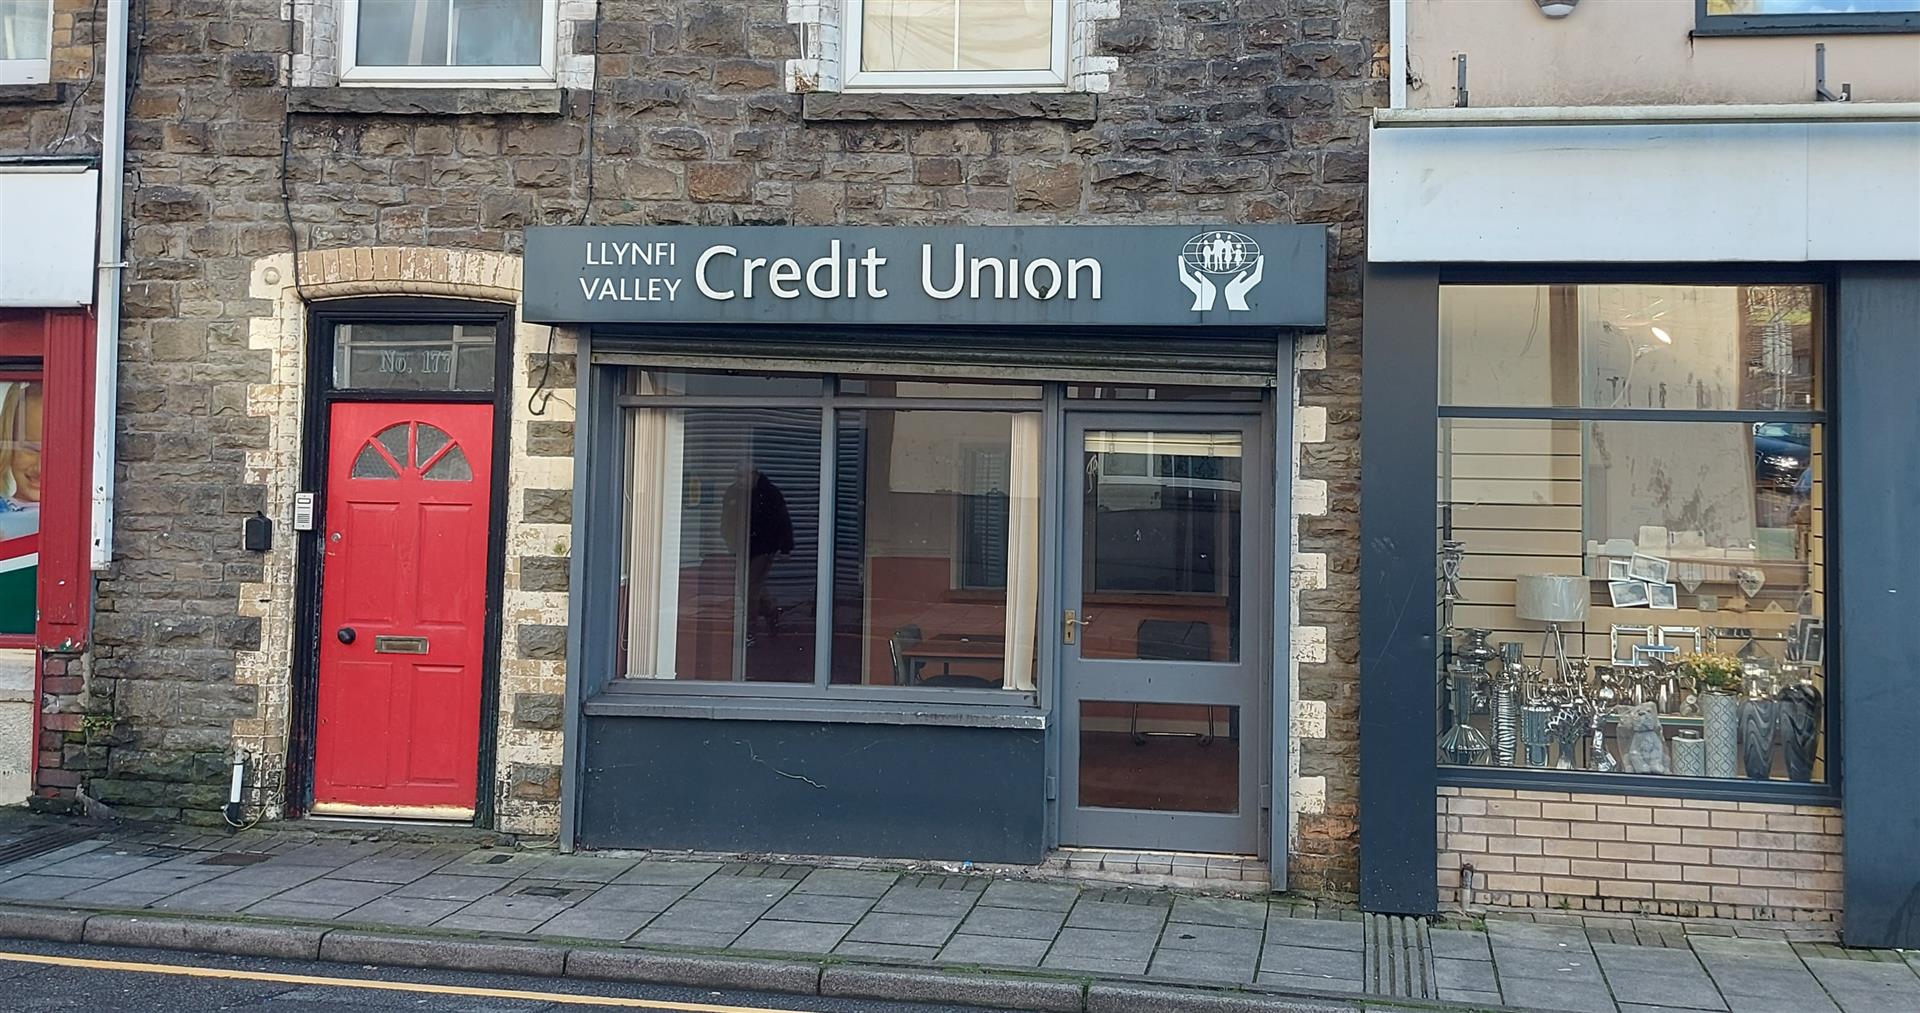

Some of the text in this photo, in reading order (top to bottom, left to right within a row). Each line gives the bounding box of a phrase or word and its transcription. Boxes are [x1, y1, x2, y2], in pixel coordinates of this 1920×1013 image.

[585, 242, 676, 266] LLYNFI
[695, 239, 1103, 300] Credit Union
[579, 277, 682, 301] VALLEY
[379, 349, 455, 374] No. 177
